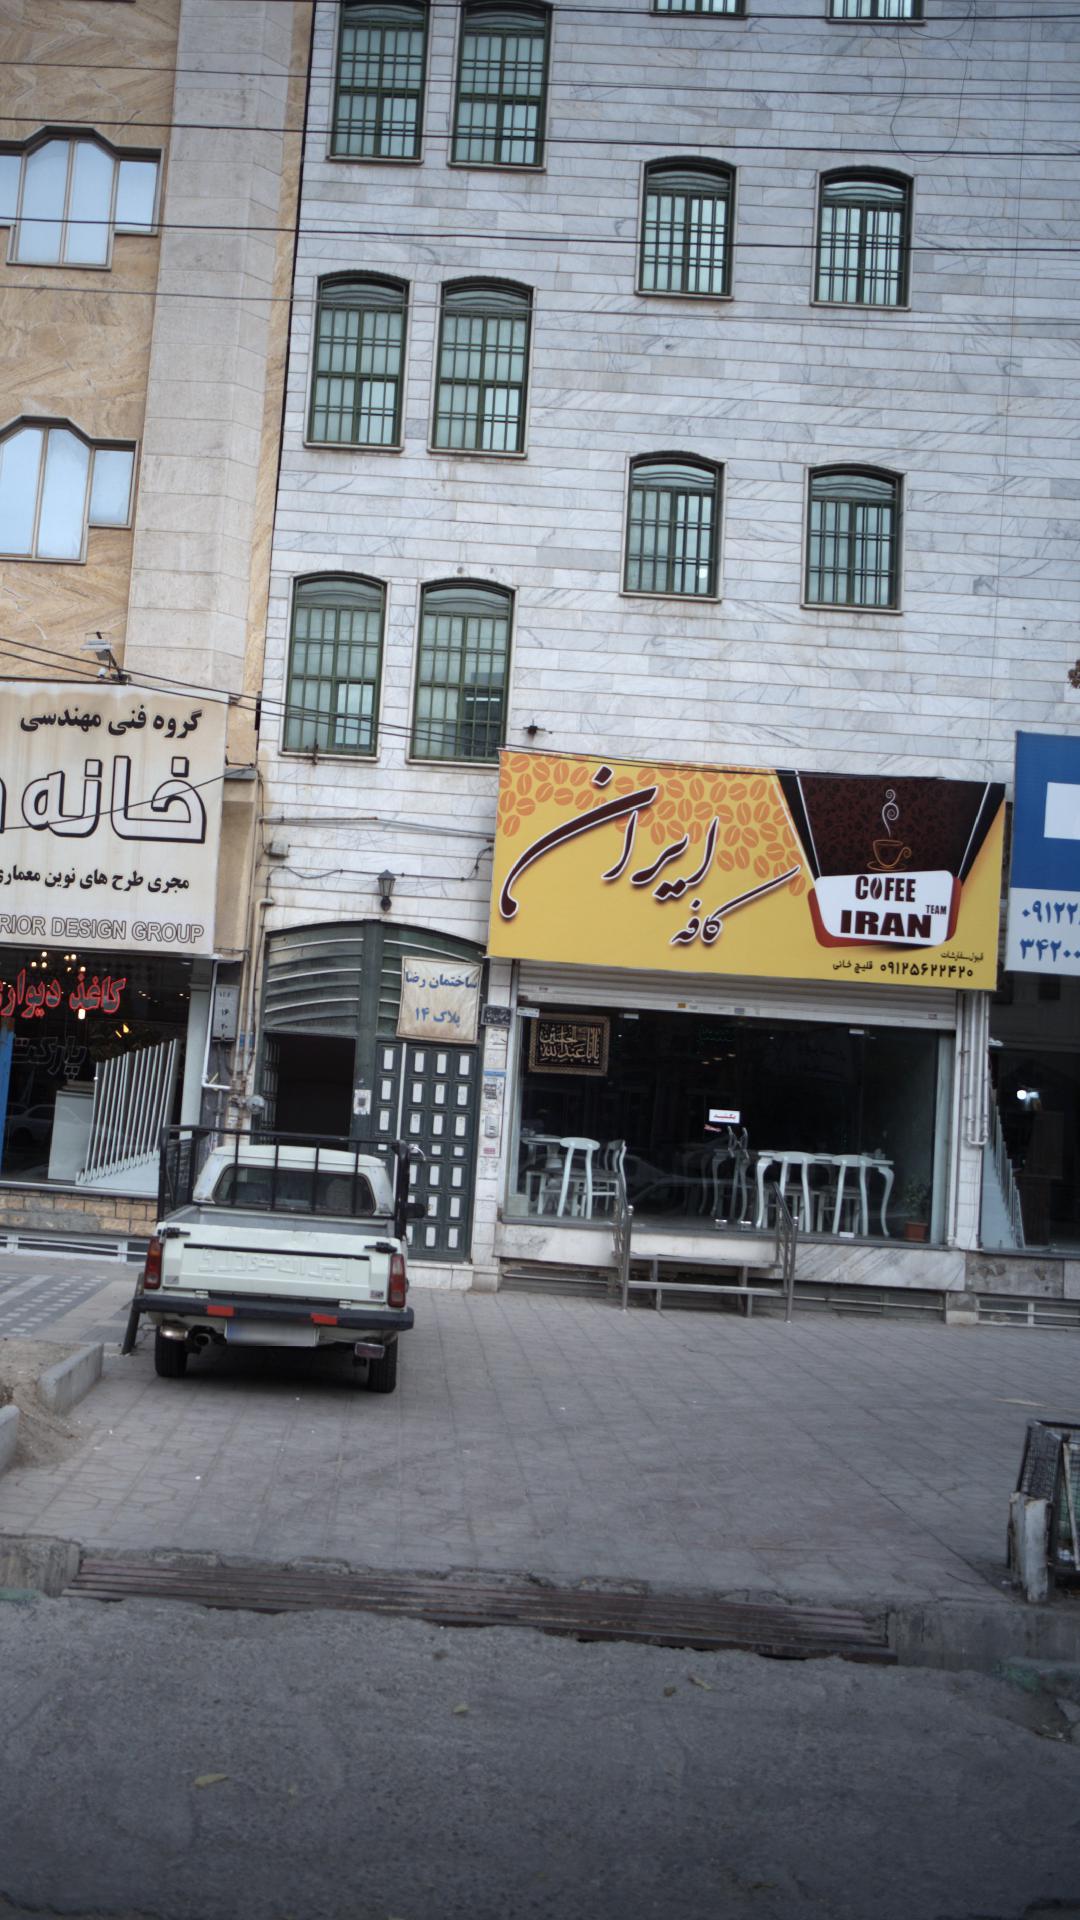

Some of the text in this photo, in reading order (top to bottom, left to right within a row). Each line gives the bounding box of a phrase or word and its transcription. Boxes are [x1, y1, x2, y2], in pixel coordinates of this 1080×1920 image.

[20, 704, 202, 738] گروه فنی مهندسی
[21, 755, 207, 844] خانه
[499, 765, 720, 919] ایران
[44, 867, 76, 889] نوین
[79, 867, 108, 890] های
[112, 870, 144, 891] طرح
[147, 868, 190, 894] مجری
[855, 875, 917, 903] COFEE
[669, 864, 801, 945] کافه
[925, 904, 948, 916] TEAM
[51, 917, 127, 940] DESIGN
[131, 921, 205, 945] GROUP
[840, 909, 932, 939] IRAN
[405, 969, 479, 989] ساختمان رضا
[880, 961, 973, 978] ۰۹۱۲۵۶۲۲۴۲۰
[0, 968, 127, 1018] کاغذ دیوار
[415, 1007, 460, 1028] پلاک ۱۴
